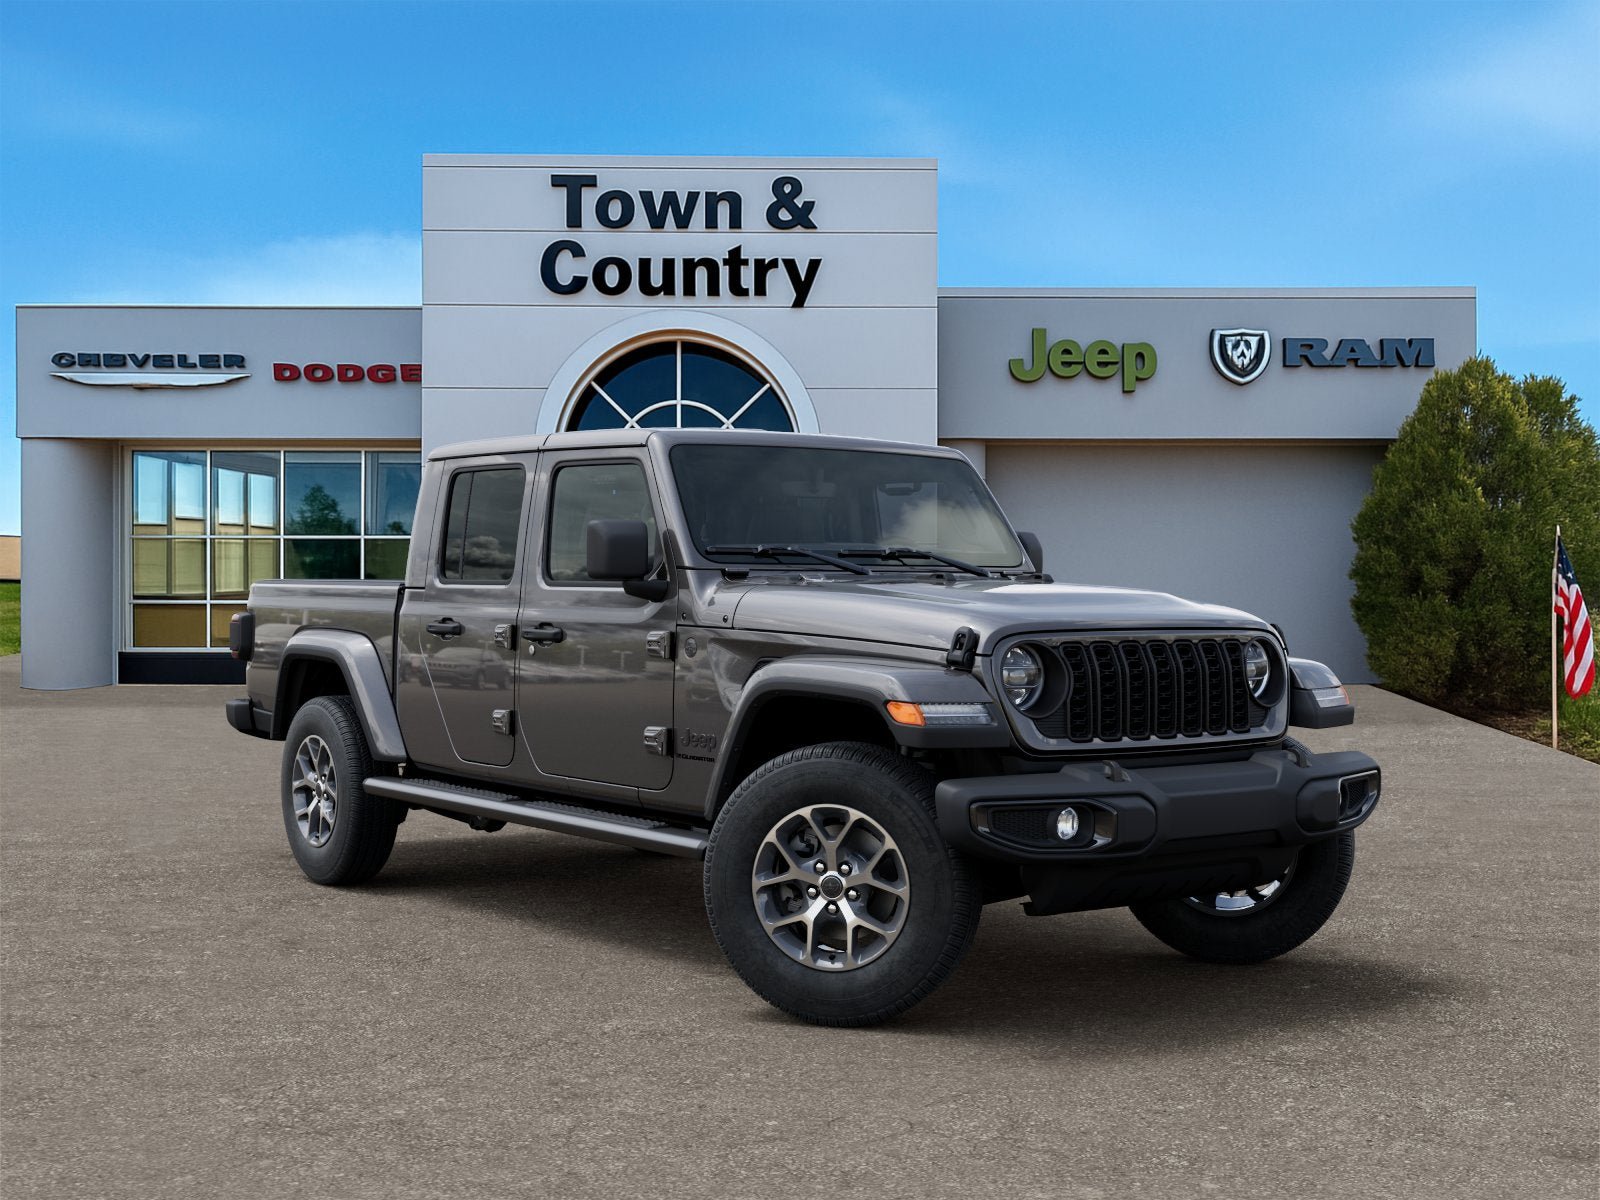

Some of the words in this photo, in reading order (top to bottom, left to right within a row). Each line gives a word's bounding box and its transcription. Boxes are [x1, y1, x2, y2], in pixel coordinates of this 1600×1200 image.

[550, 174, 742, 229] Town
[765, 176, 818, 230] &
[539, 239, 822, 308] Country
[273, 363, 422, 383] DODGE
[1009, 328, 1158, 392] Jeep
[1282, 337, 1435, 368] RAM
[680, 728, 717, 752] Jeep
